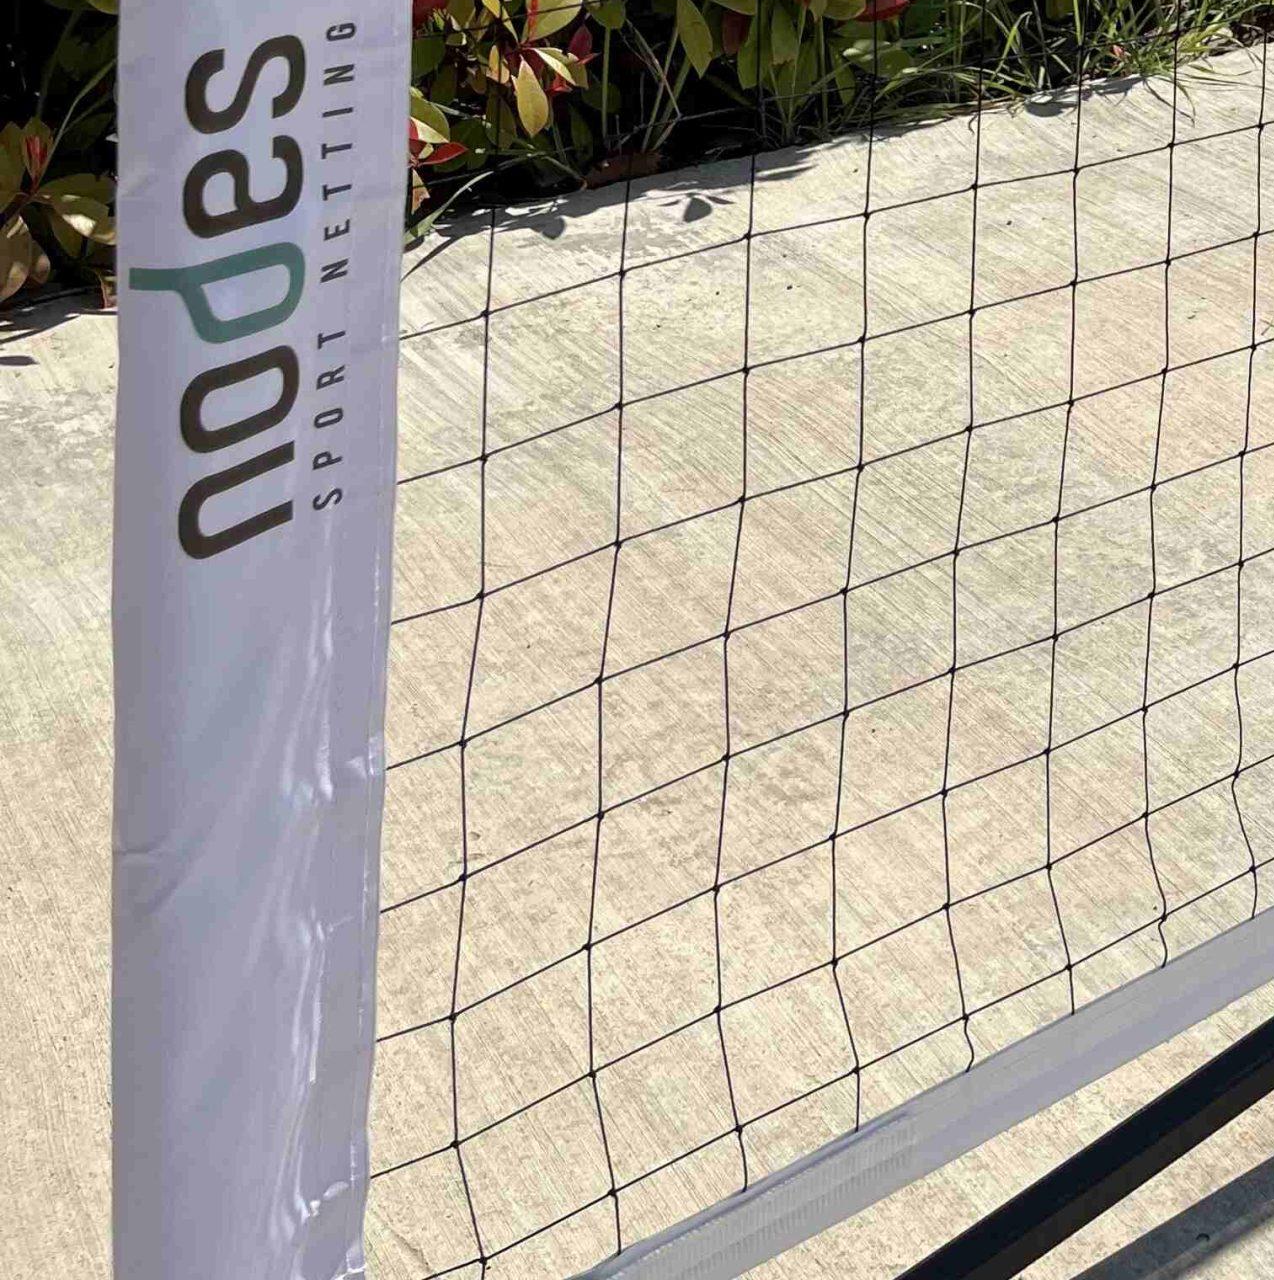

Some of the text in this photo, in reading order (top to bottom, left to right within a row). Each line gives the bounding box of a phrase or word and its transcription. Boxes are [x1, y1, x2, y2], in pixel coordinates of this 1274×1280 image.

[129, 34, 307, 560] nodes
[313, 20, 357, 512] SPORT NETTING
